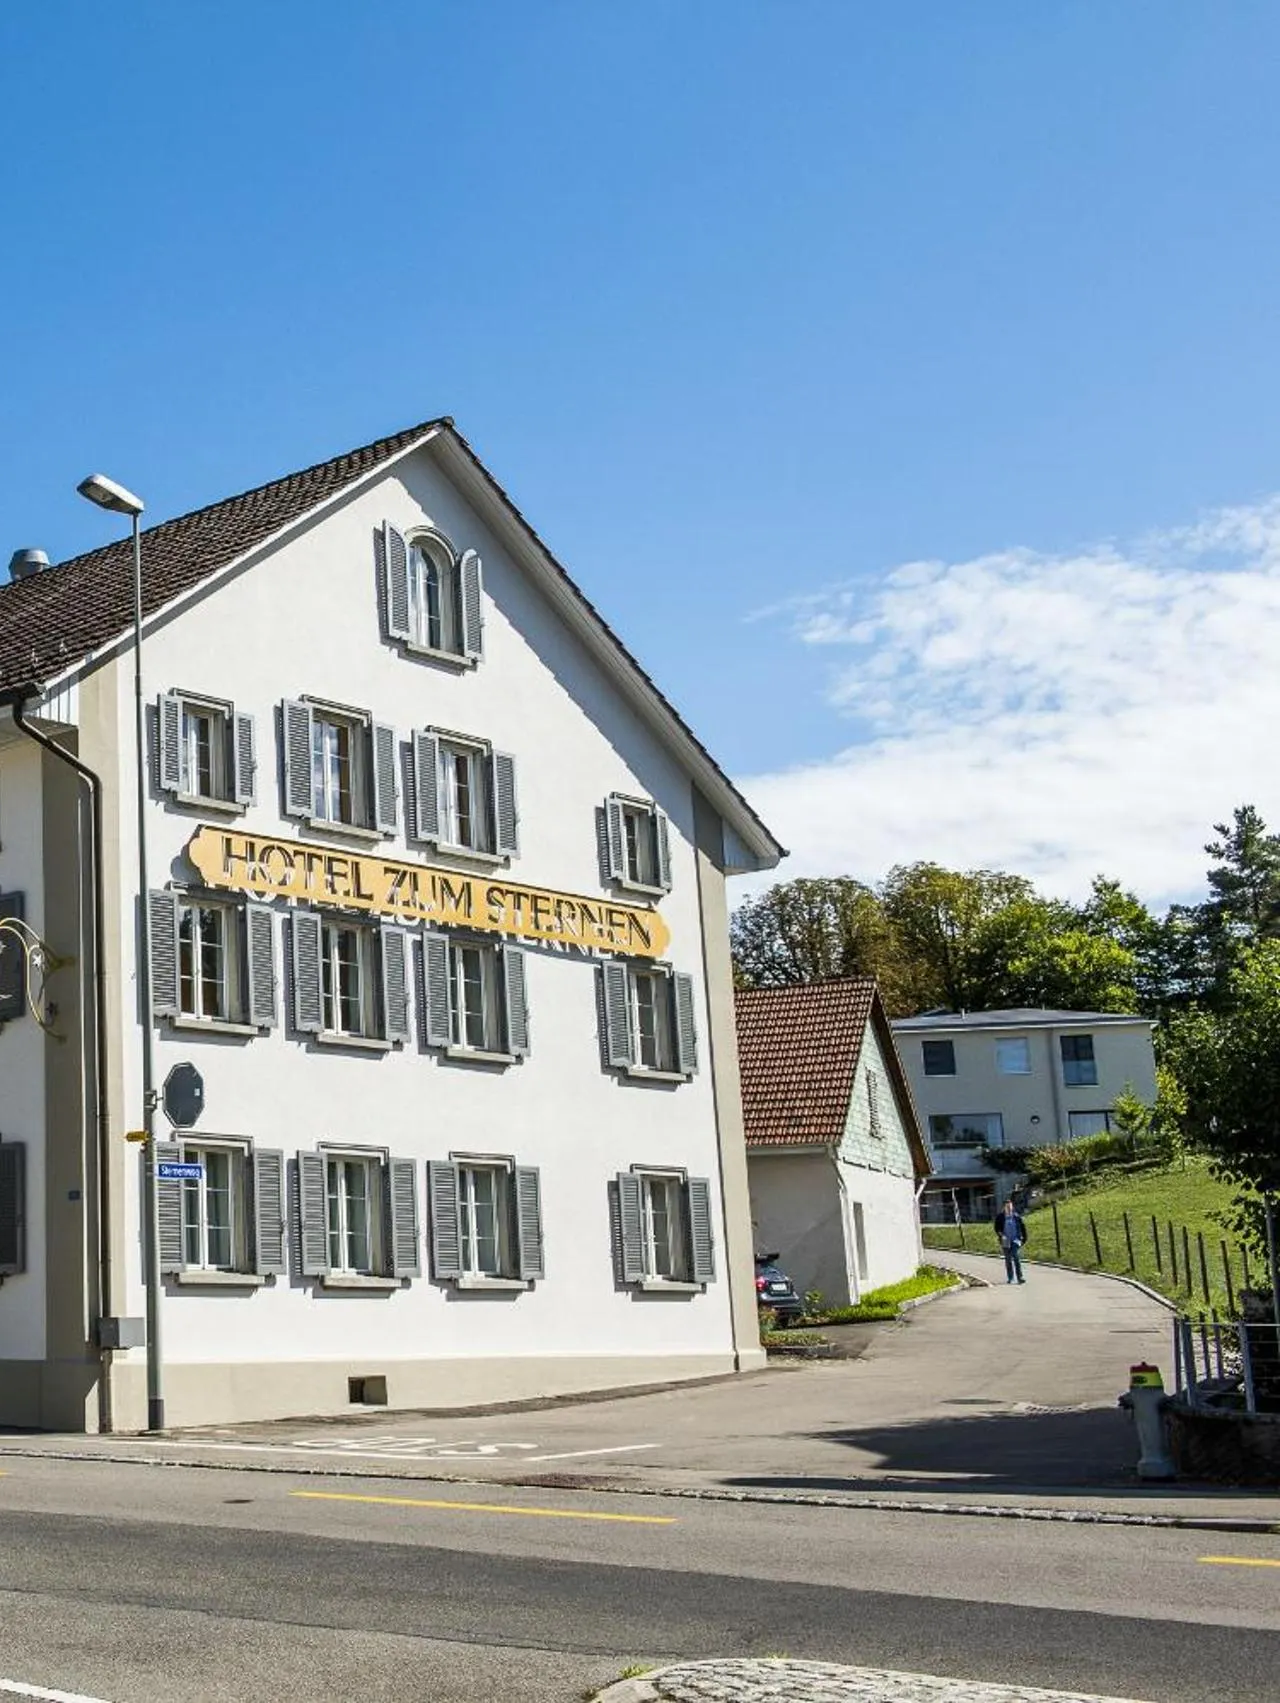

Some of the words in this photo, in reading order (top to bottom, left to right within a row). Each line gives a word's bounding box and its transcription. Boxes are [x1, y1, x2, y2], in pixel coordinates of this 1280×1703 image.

[221, 836, 374, 900] HOTEL
[383, 866, 473, 918] ZUM
[486, 886, 652, 949] STERNEN
